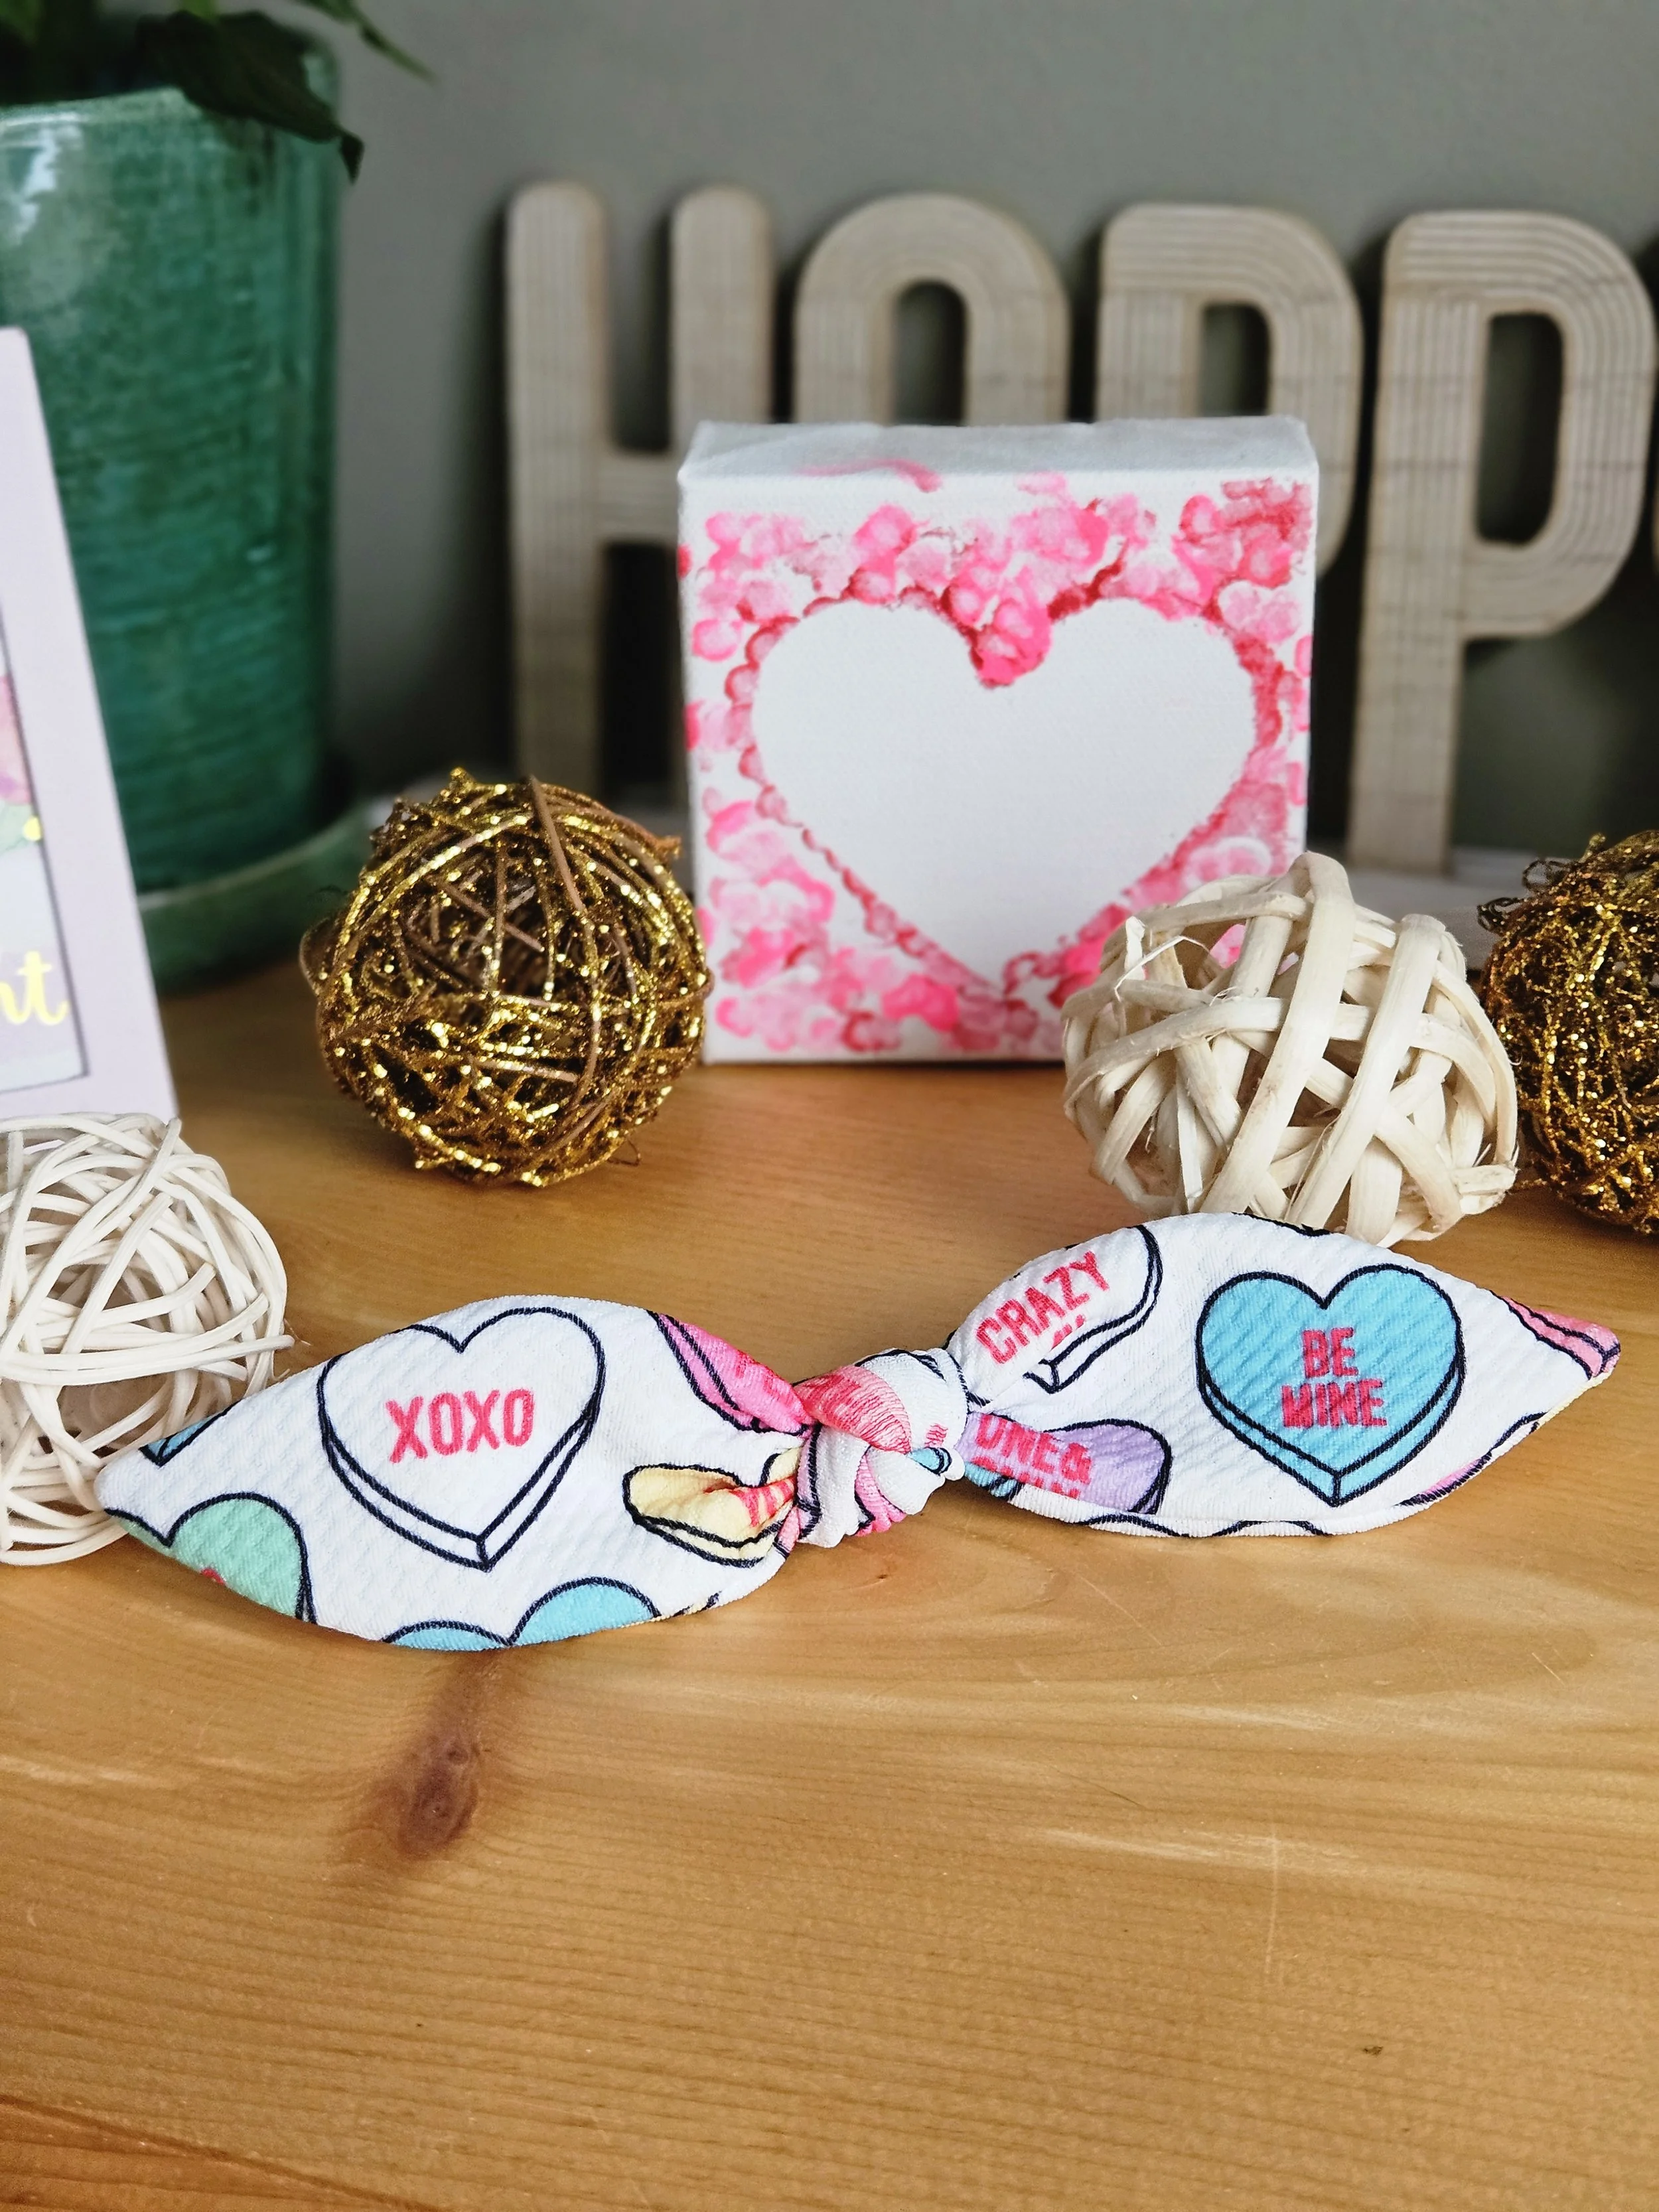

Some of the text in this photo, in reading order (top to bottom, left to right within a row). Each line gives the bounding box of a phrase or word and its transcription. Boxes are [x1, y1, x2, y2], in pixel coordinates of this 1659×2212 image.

[506, 181, 1659, 875] HPP
[976, 1251, 1109, 1364] CRAZY
[1303, 1327, 1358, 1378] BE
[386, 1388, 535, 1463] XOXO
[1282, 1378, 1388, 1428] MINE
